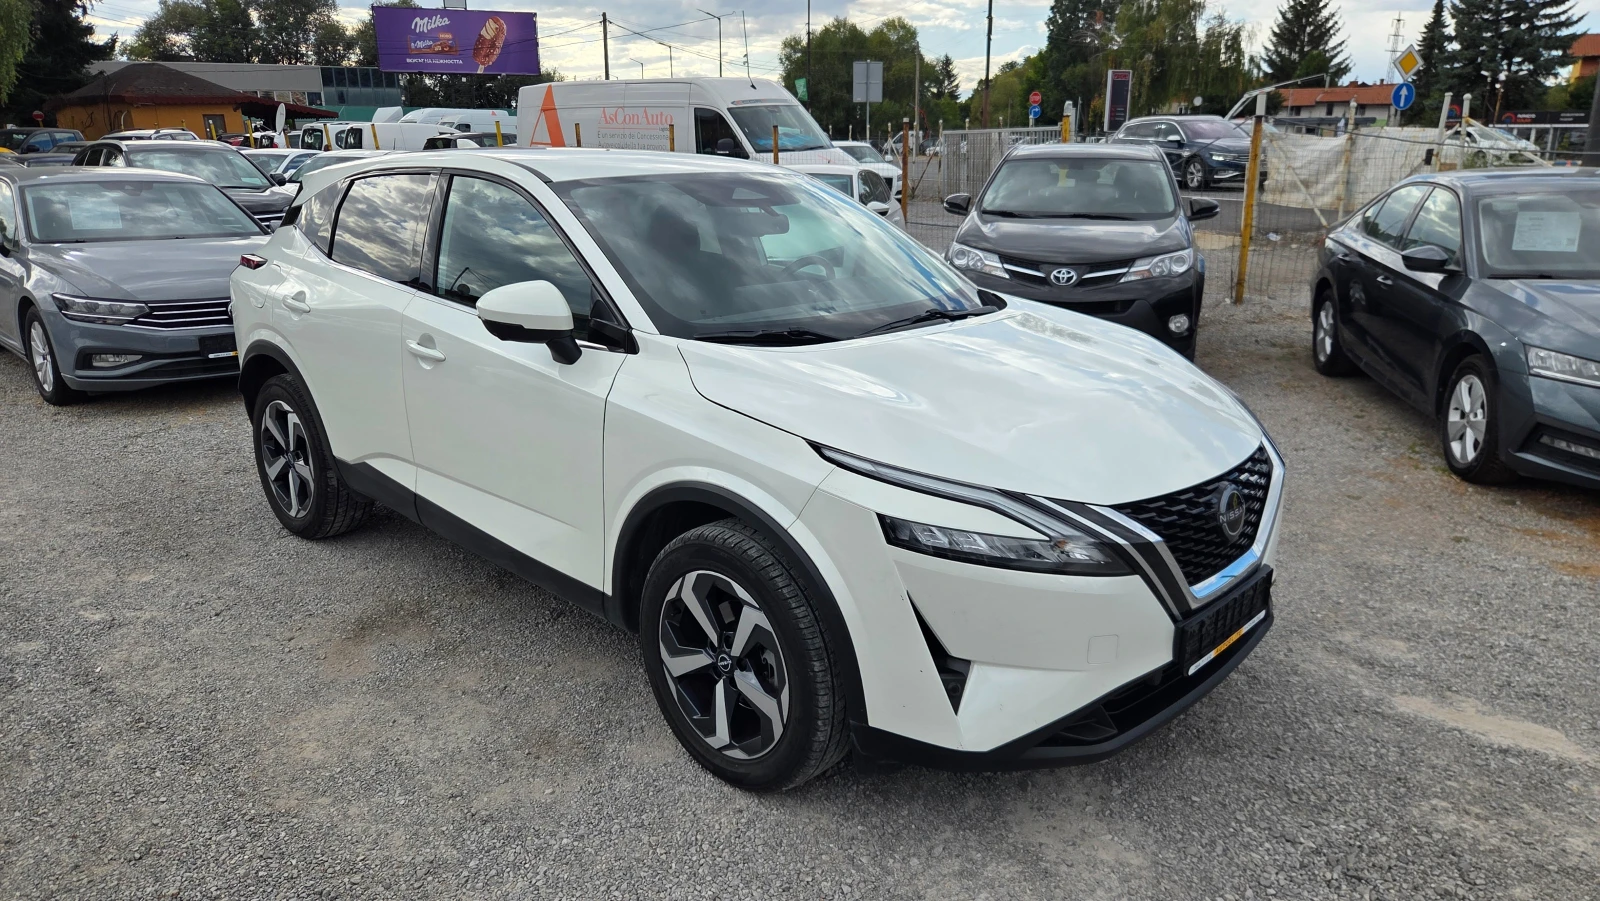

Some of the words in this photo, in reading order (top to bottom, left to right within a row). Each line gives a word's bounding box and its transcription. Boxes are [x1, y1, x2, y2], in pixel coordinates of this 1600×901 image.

[411, 14, 451, 33] Milka
[415, 40, 433, 49] Milka
[597, 106, 674, 125] AsConAuto
[628, 131, 636, 140] dei
[636, 132, 669, 141] Concessiona
